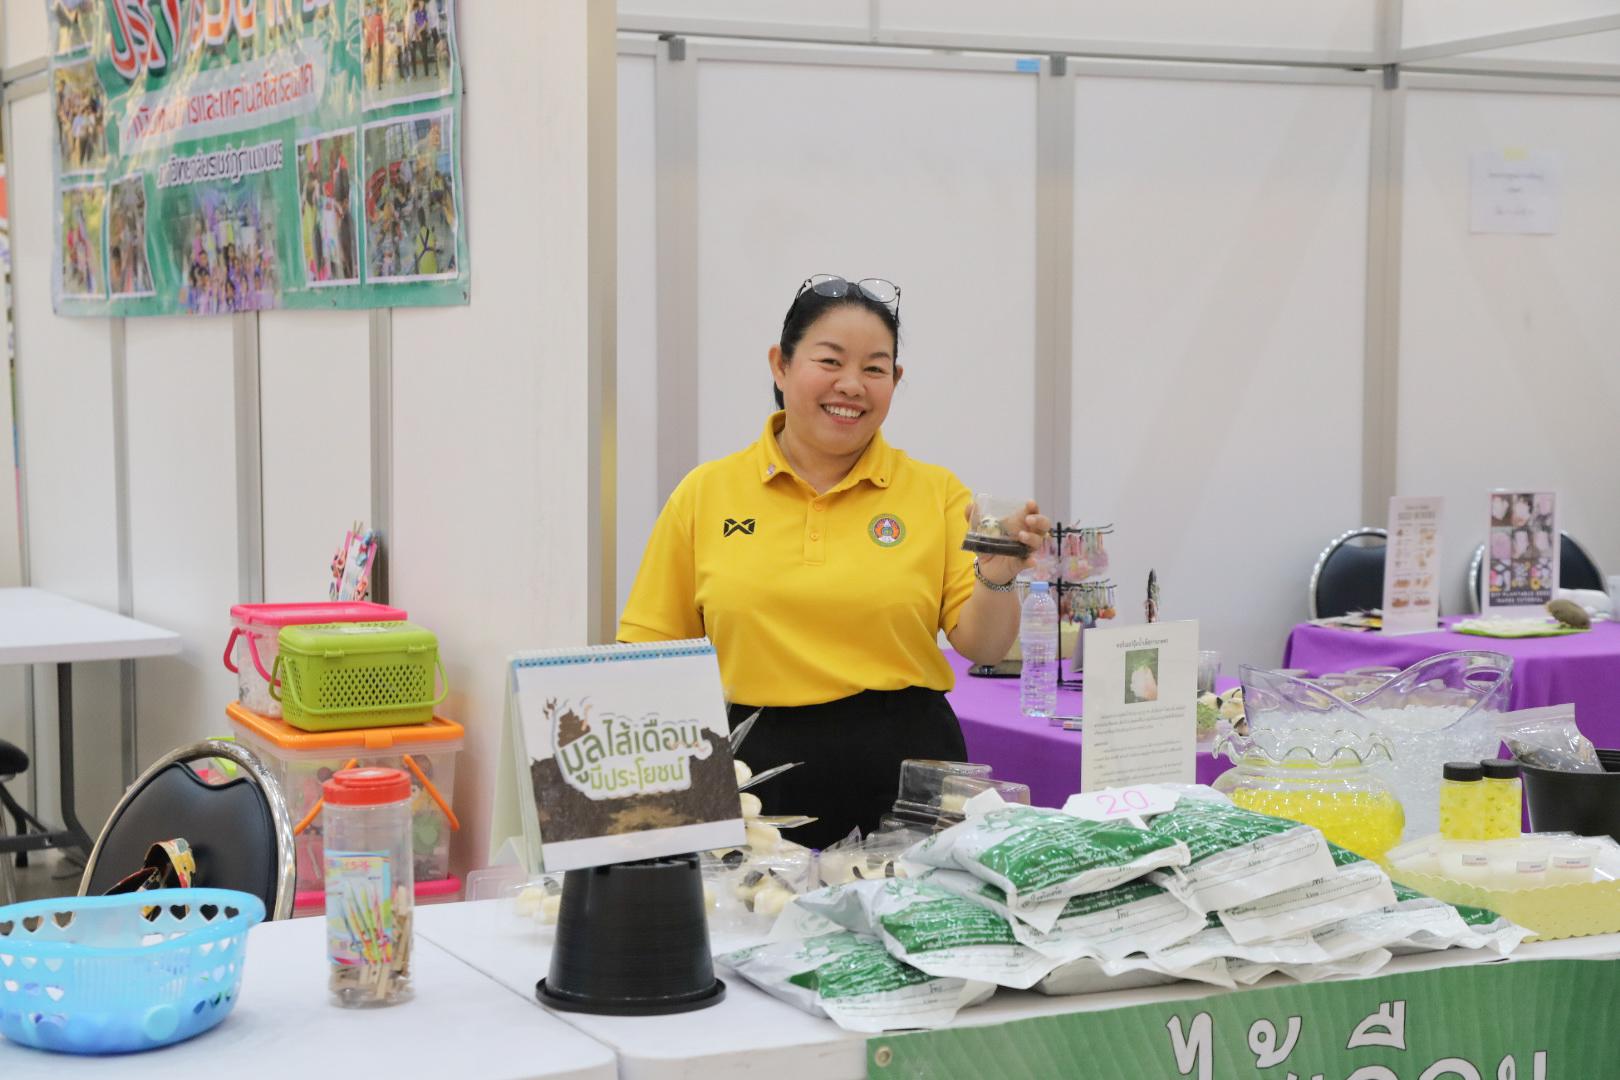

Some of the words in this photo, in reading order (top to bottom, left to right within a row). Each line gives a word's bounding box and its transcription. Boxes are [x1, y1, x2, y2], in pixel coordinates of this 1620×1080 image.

[561, 719, 700, 784] มูลไส้เดือน
[590, 756, 685, 792] มีประโยชน์
[1096, 790, 1149, 815] 20
